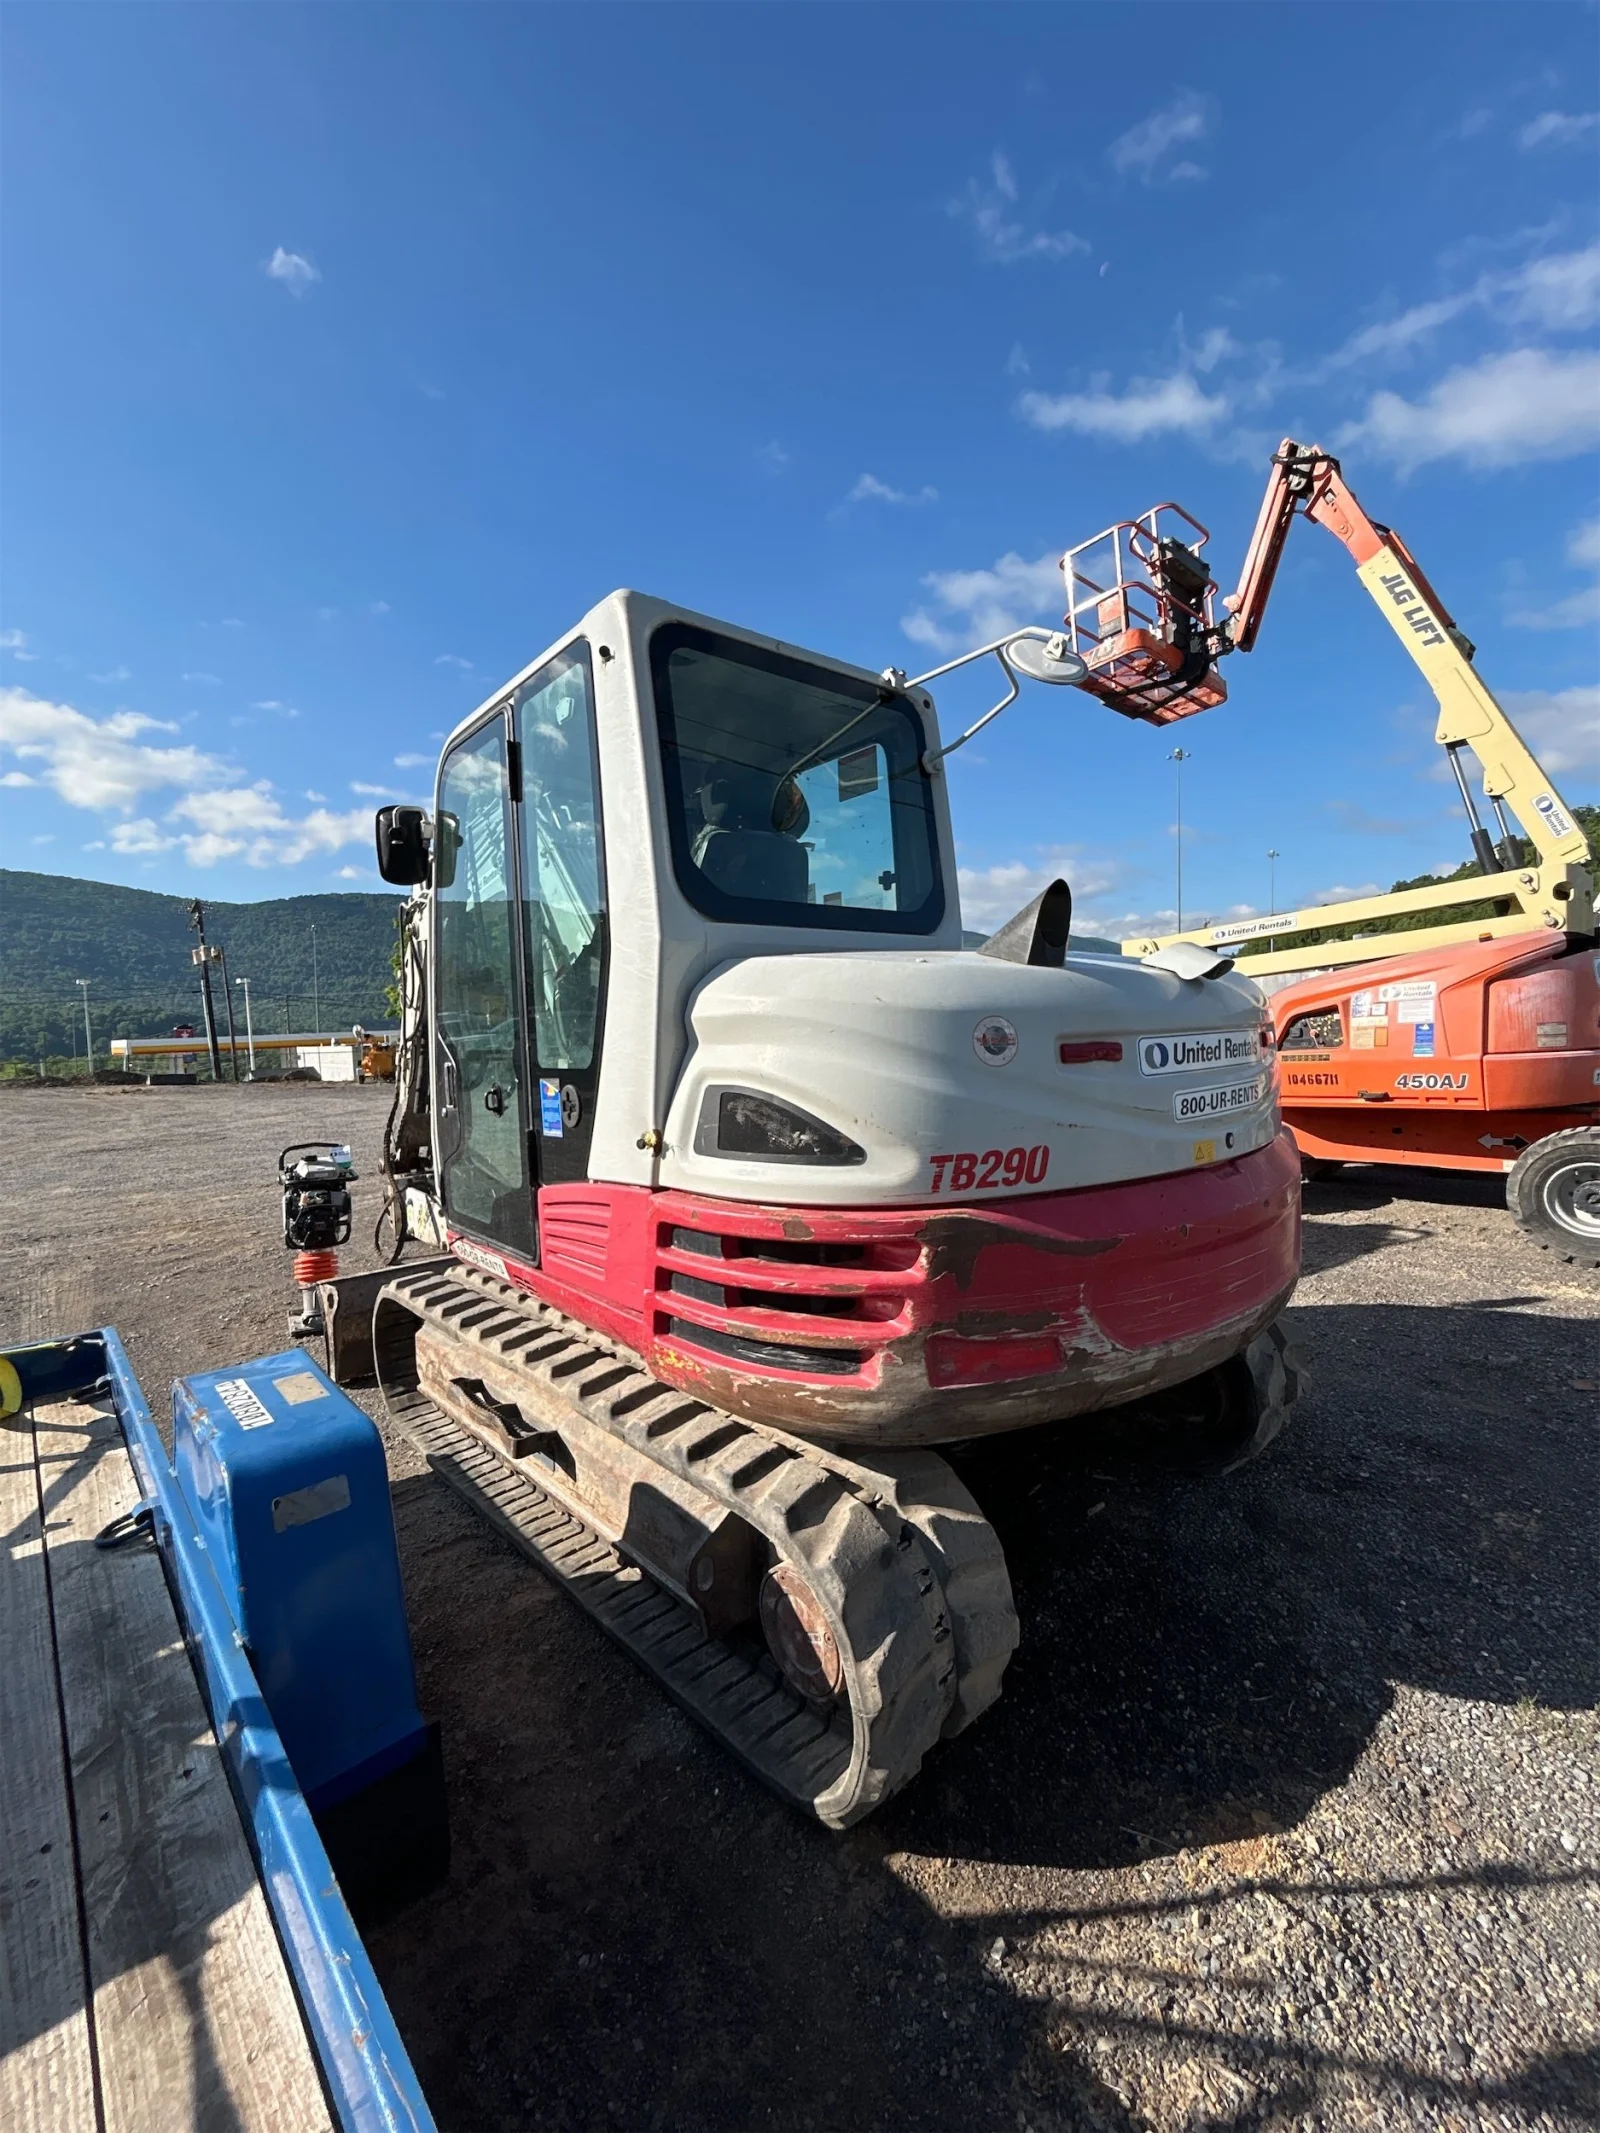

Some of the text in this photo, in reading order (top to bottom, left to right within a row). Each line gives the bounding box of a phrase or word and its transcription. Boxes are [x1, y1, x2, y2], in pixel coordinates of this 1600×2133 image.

[1379, 573, 1446, 647] JLG LIFT
[1543, 813, 1562, 837] Rentals
[1551, 810, 1570, 831] United
[1227, 918, 1293, 937] United Rentals
[1173, 1037, 1258, 1065] United Rentals
[1287, 1073, 1339, 1085] 10466711
[1396, 1074, 1467, 1089] 450AJ
[1180, 1083, 1260, 1116] 800-UR-RENTS
[929, 1145, 1050, 1193] TB290
